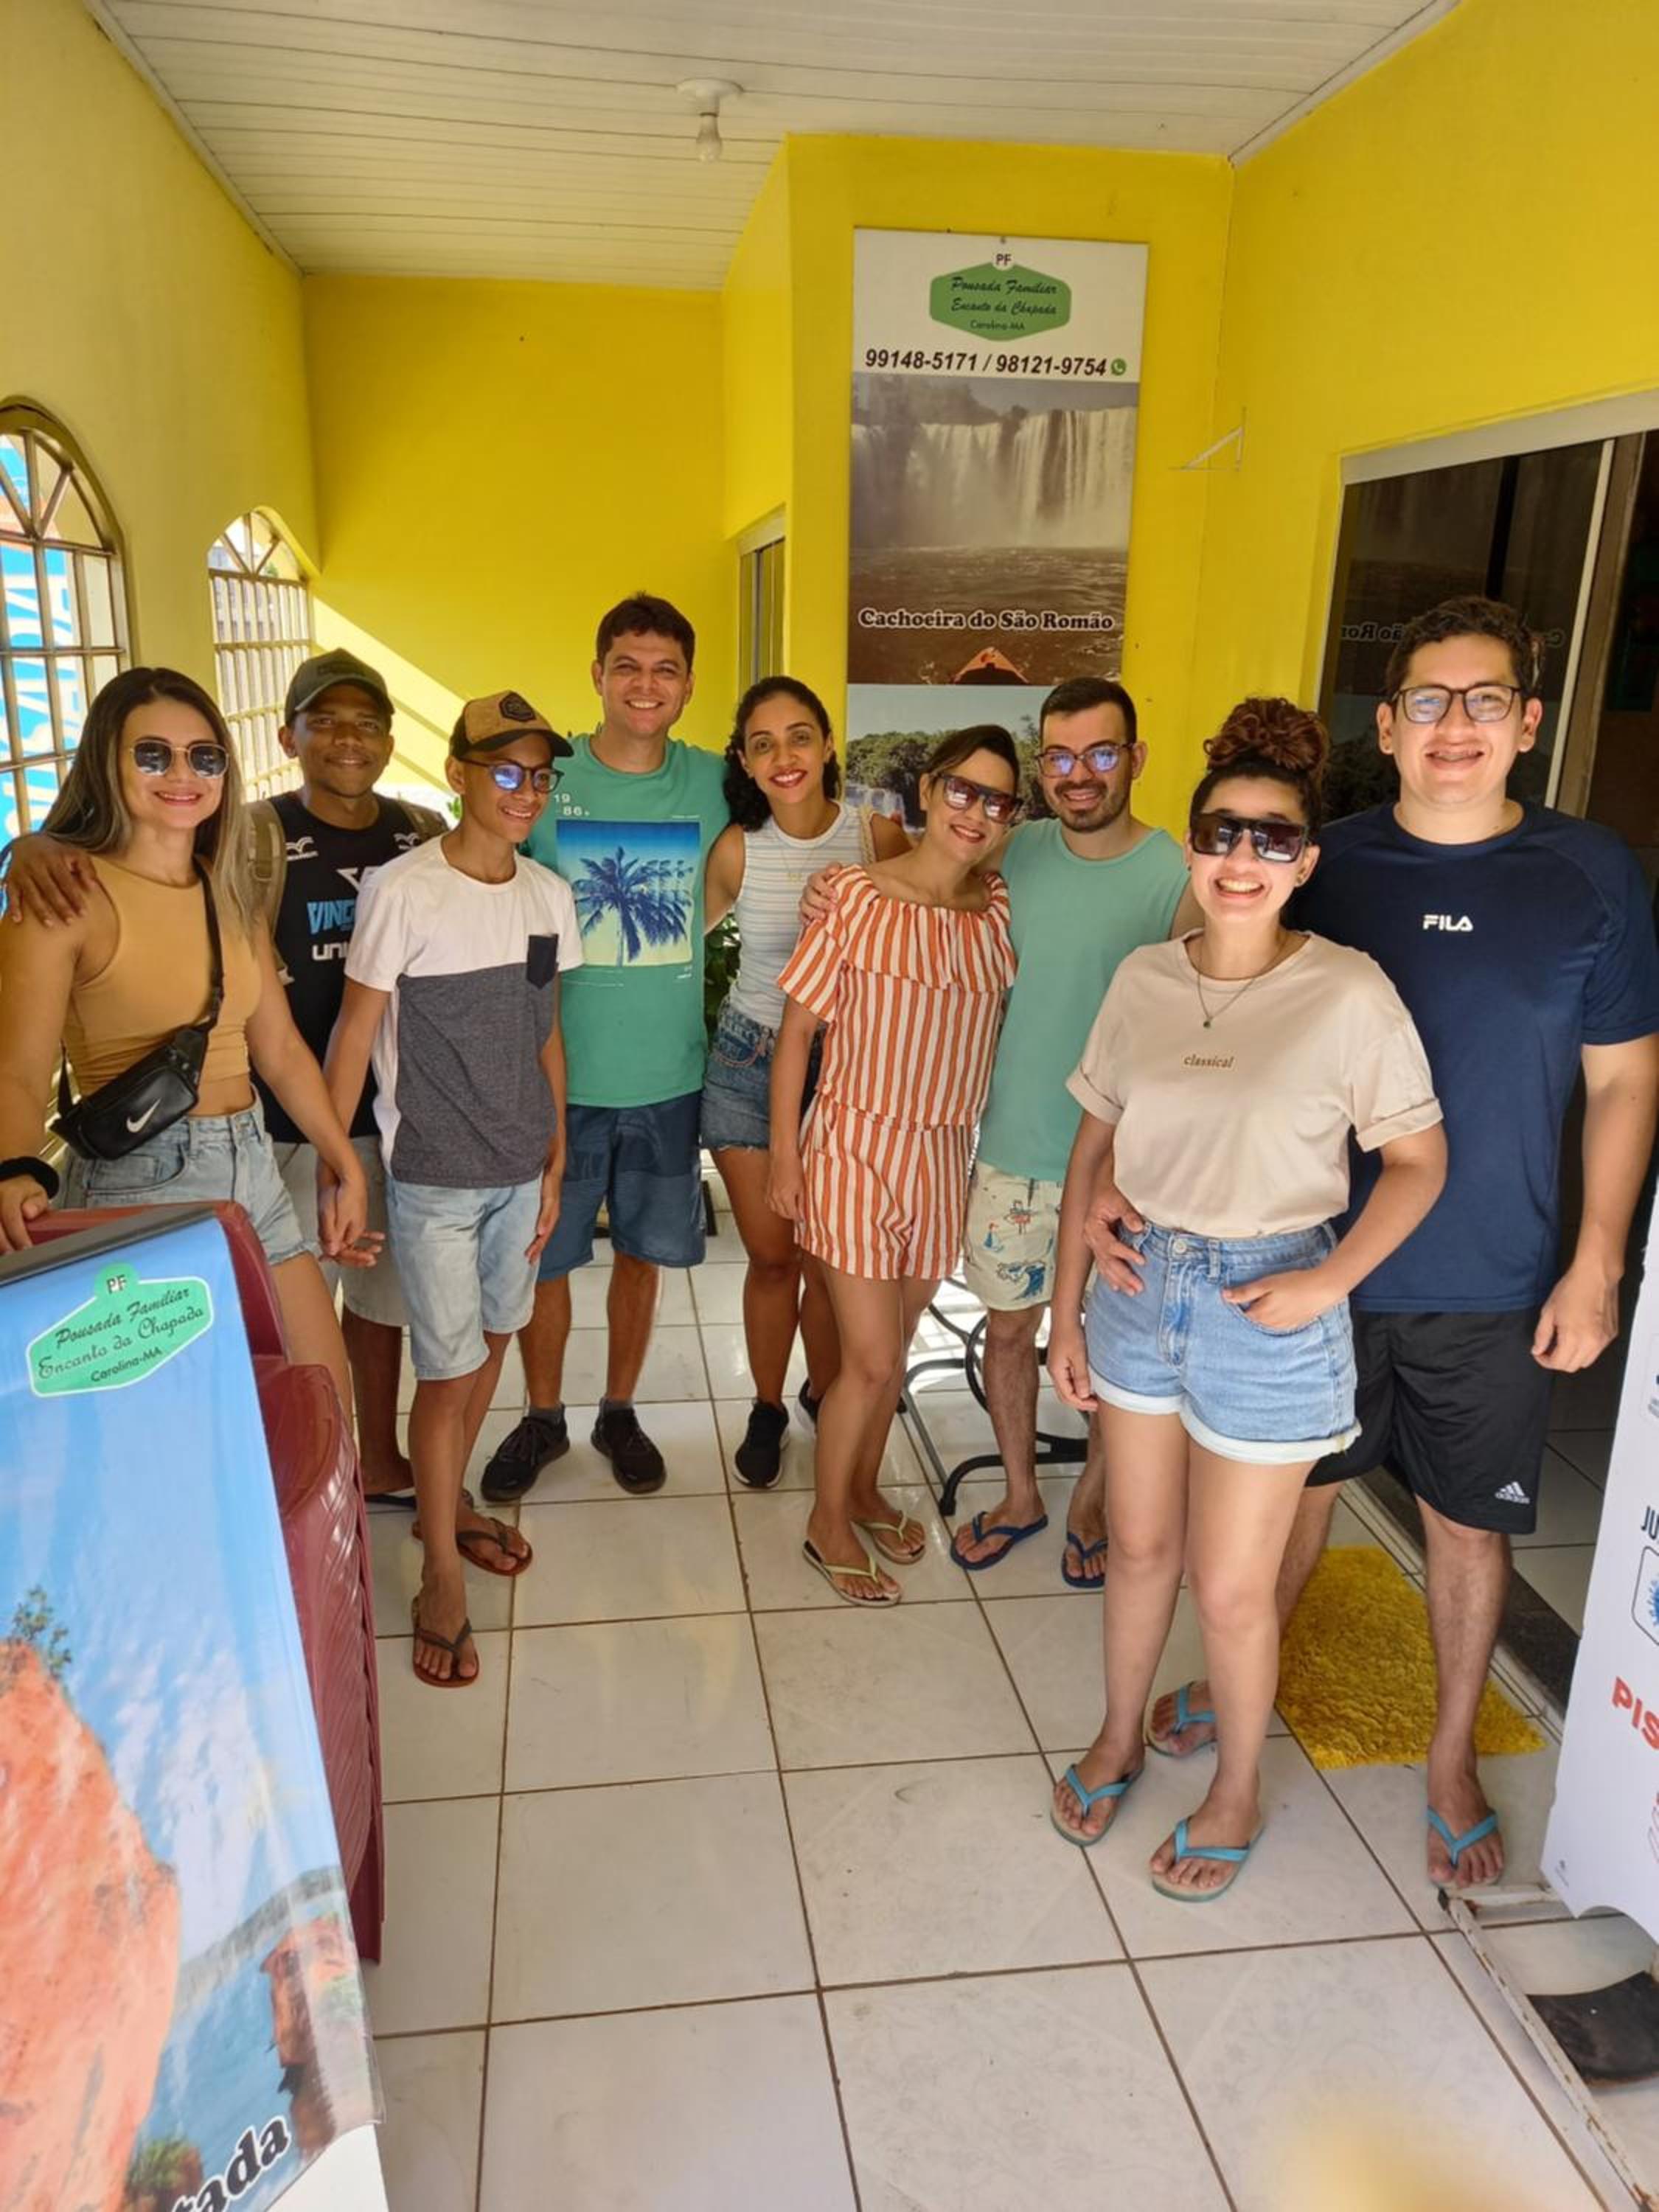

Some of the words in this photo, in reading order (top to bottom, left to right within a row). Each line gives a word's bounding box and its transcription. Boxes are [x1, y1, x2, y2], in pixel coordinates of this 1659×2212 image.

[996, 254, 1012, 265] PF
[951, 276, 1001, 291] Pousada
[1005, 279, 1057, 295] Familiar
[951, 297, 991, 311] Encanto
[995, 301, 1006, 312] da
[1011, 300, 1057, 316] Chapada
[865, 349, 978, 370] 99148-5171
[982, 354, 992, 371] /
[996, 354, 1107, 376] 98121-9754
[859, 608, 964, 627] Cachoeira
[970, 611, 995, 627] do
[1001, 612, 1037, 629] São
[1042, 613, 1113, 630] Romão
[554, 793, 571, 803] 19
[1423, 914, 1473, 931] FILA
[1183, 1054, 1235, 1068] classical
[106, 1274, 126, 1294] PF
[55, 1312, 122, 1349] Pousada
[127, 1288, 189, 1322] Familiar
[38, 1342, 108, 1379] Encanto
[114, 1335, 133, 1351] da
[138, 1306, 204, 1339] Chapada
[91, 1346, 163, 1382] Carolina-MA
